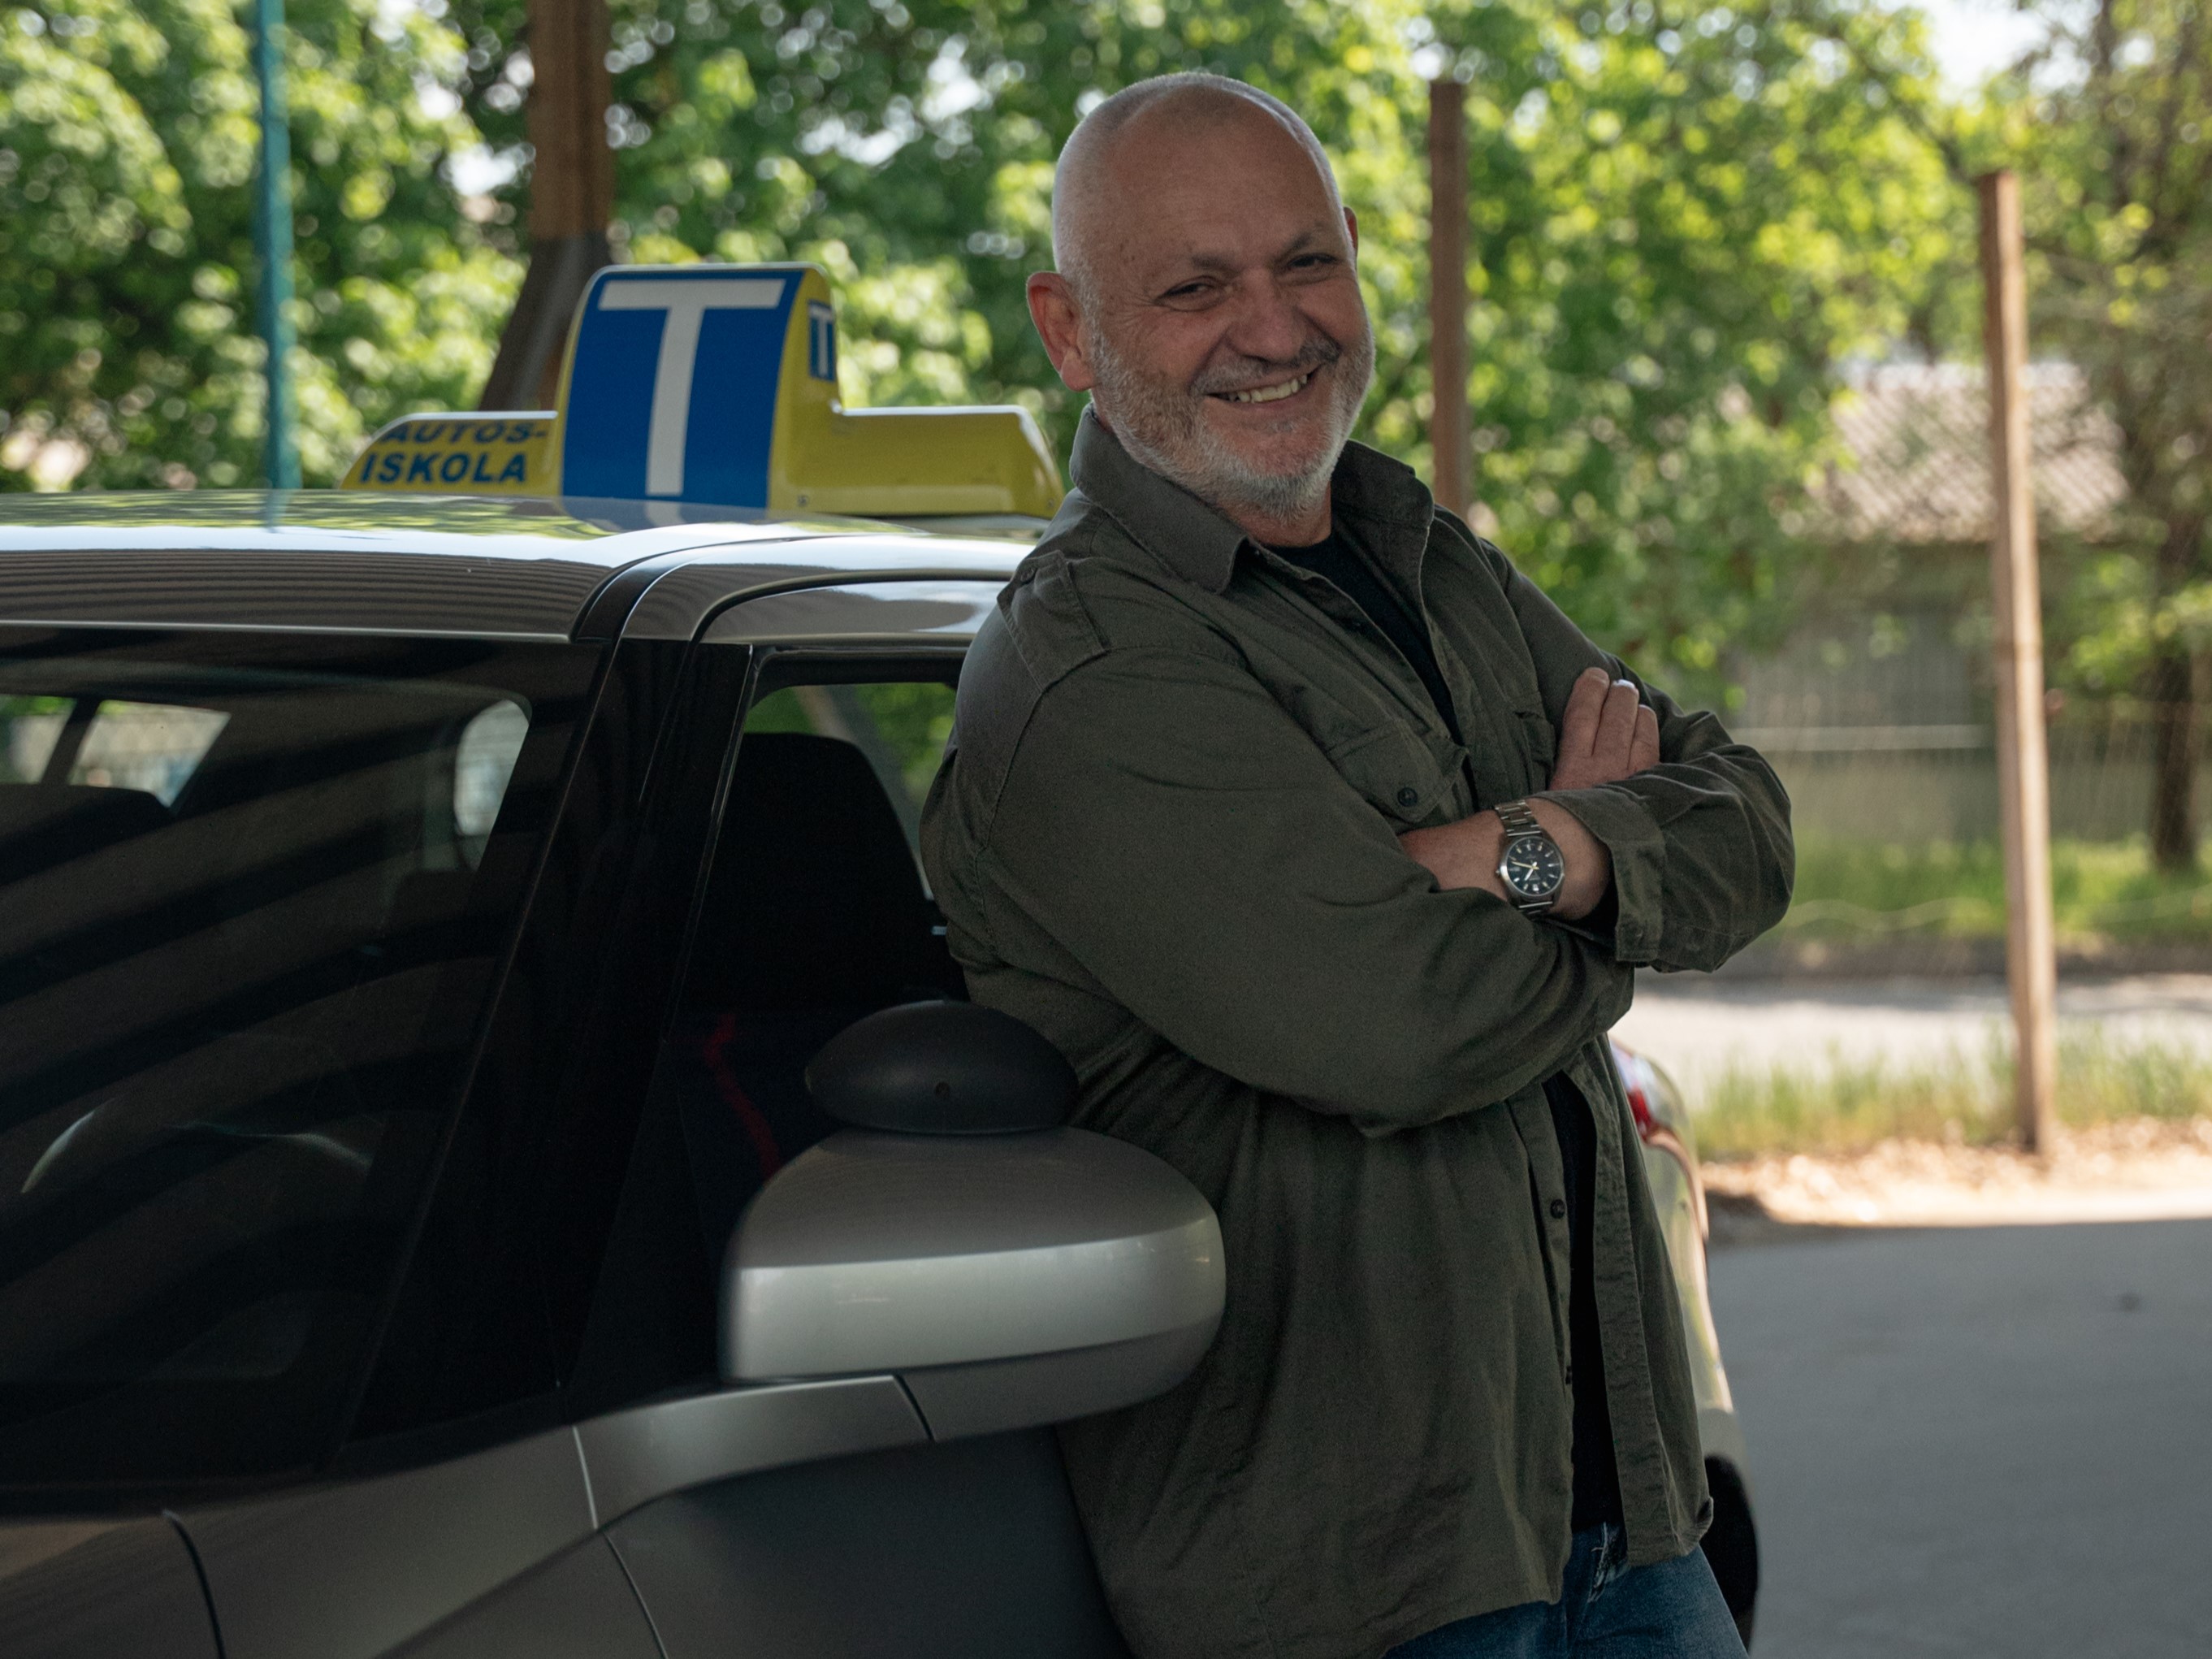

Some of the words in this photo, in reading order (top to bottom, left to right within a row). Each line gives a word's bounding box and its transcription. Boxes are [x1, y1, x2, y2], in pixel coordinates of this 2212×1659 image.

[810, 304, 833, 376] T
[598, 278, 786, 496] T
[361, 453, 526, 483] ISKOLA
